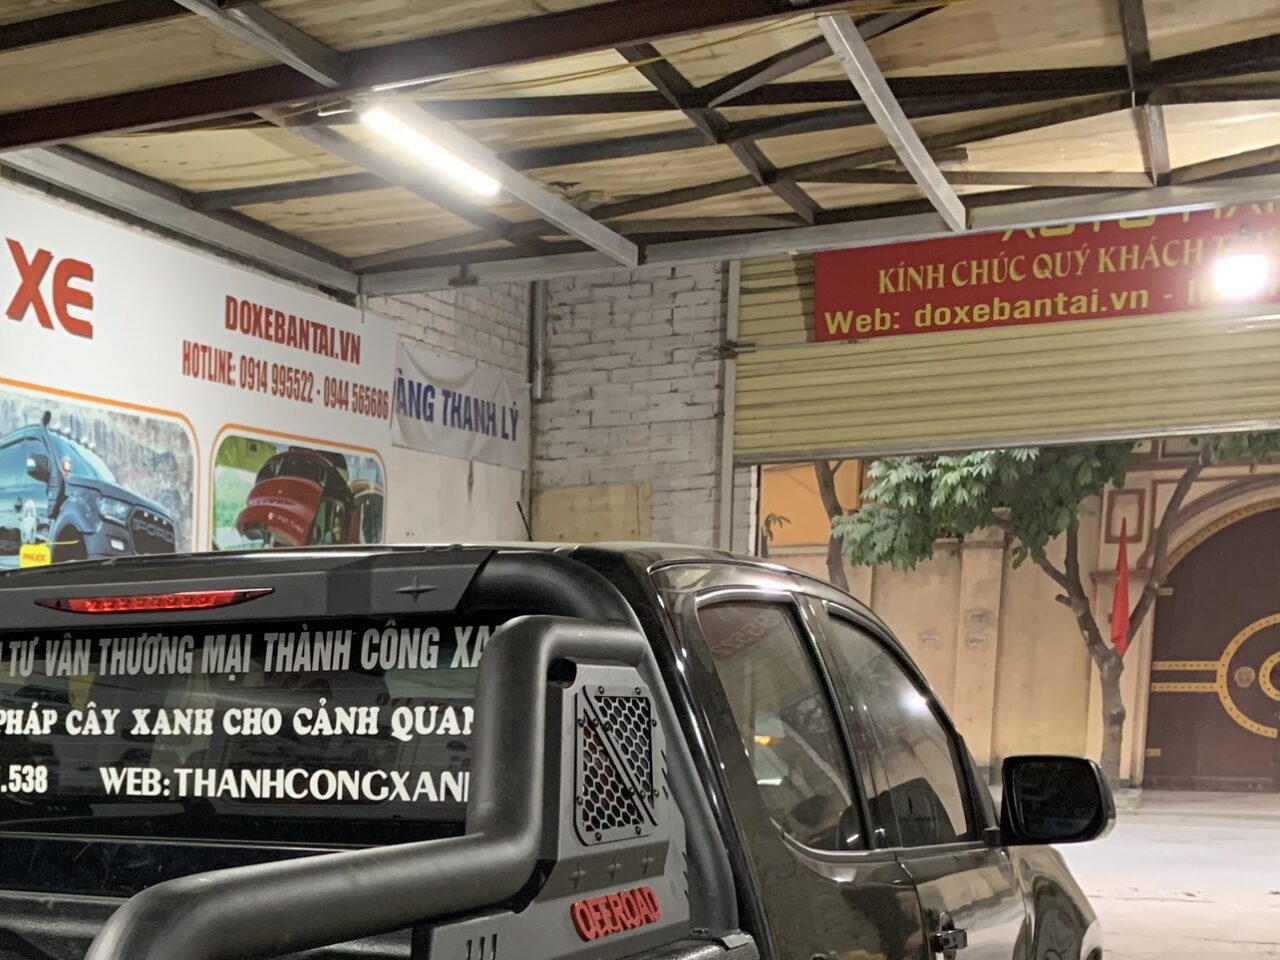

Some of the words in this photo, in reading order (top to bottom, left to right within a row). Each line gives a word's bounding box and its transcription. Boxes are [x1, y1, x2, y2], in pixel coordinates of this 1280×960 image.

[5, 237, 94, 340] XE
[877, 261, 945, 294] KÍNH
[951, 252, 1026, 288] CHÚC
[1032, 243, 1091, 280] QUÝ
[1097, 236, 1204, 274] KHÁCH
[225, 295, 362, 365] DOXEBANTAI.VN
[824, 308, 900, 335] Web:
[914, 288, 1149, 328] doxebantai.vn
[181, 340, 236, 387] HOTLINE:
[239, 355, 268, 394] 0914
[271, 363, 314, 404] 995522
[323, 375, 349, 411] 0944
[352, 382, 390, 420] 565686
[442, 389, 498, 437] THANH
[501, 400, 519, 442] LÝ
[9, 636, 40, 678] TƯ
[99, 632, 194, 675] THƯƠNG
[201, 633, 253, 682] MẠI
[264, 623, 353, 673] THÀNH
[361, 619, 440, 670] CÔNG
[450, 625, 501, 668] XA
[65, 701, 121, 736] CÂY
[130, 706, 214, 736] XANH
[222, 707, 282, 736] CHO
[293, 697, 380, 736] CẢNH
